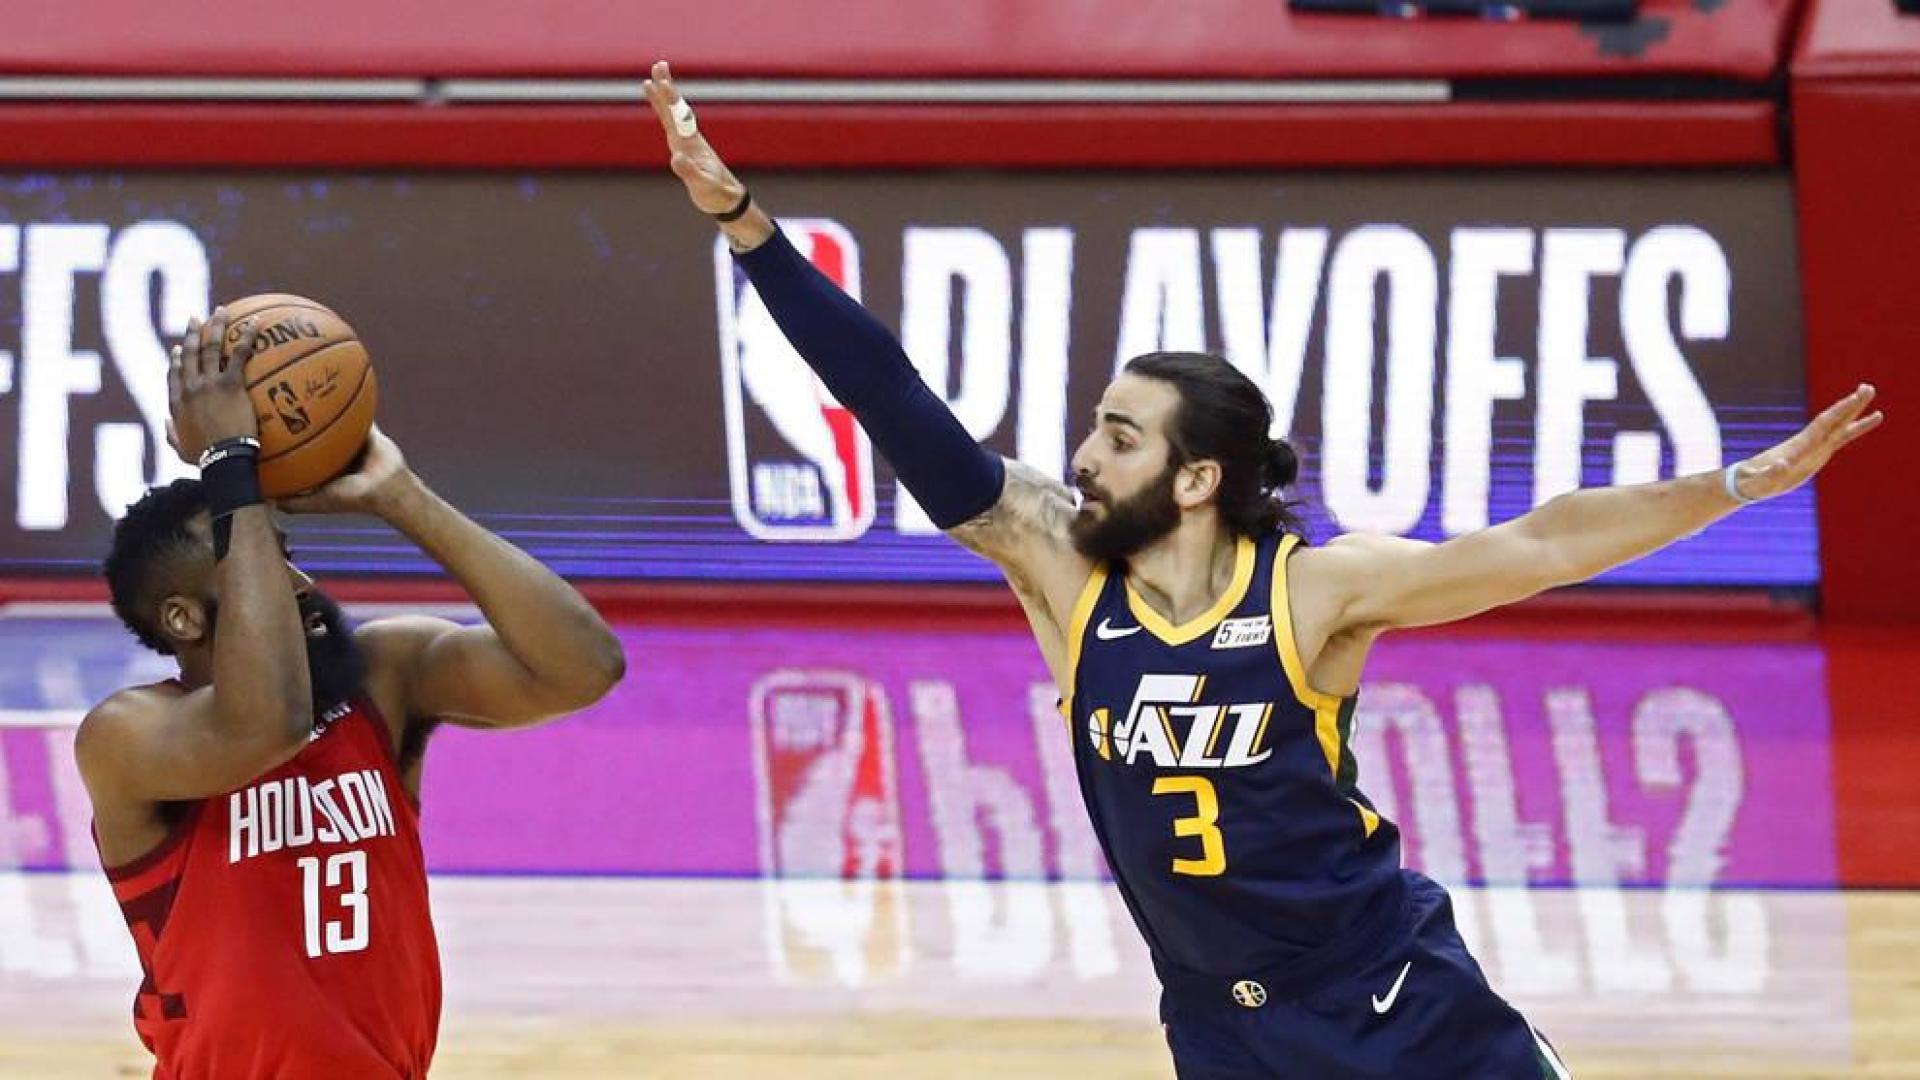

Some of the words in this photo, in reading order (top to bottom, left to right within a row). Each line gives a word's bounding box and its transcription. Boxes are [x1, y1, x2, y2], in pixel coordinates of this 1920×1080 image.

[0, 220, 211, 531] FS
[1217, 621, 1234, 645] 5
[1113, 674, 1273, 767] JAZZ
[229, 769, 396, 864] HOUSTON
[1152, 776, 1227, 876] 3
[297, 850, 370, 958] 13
